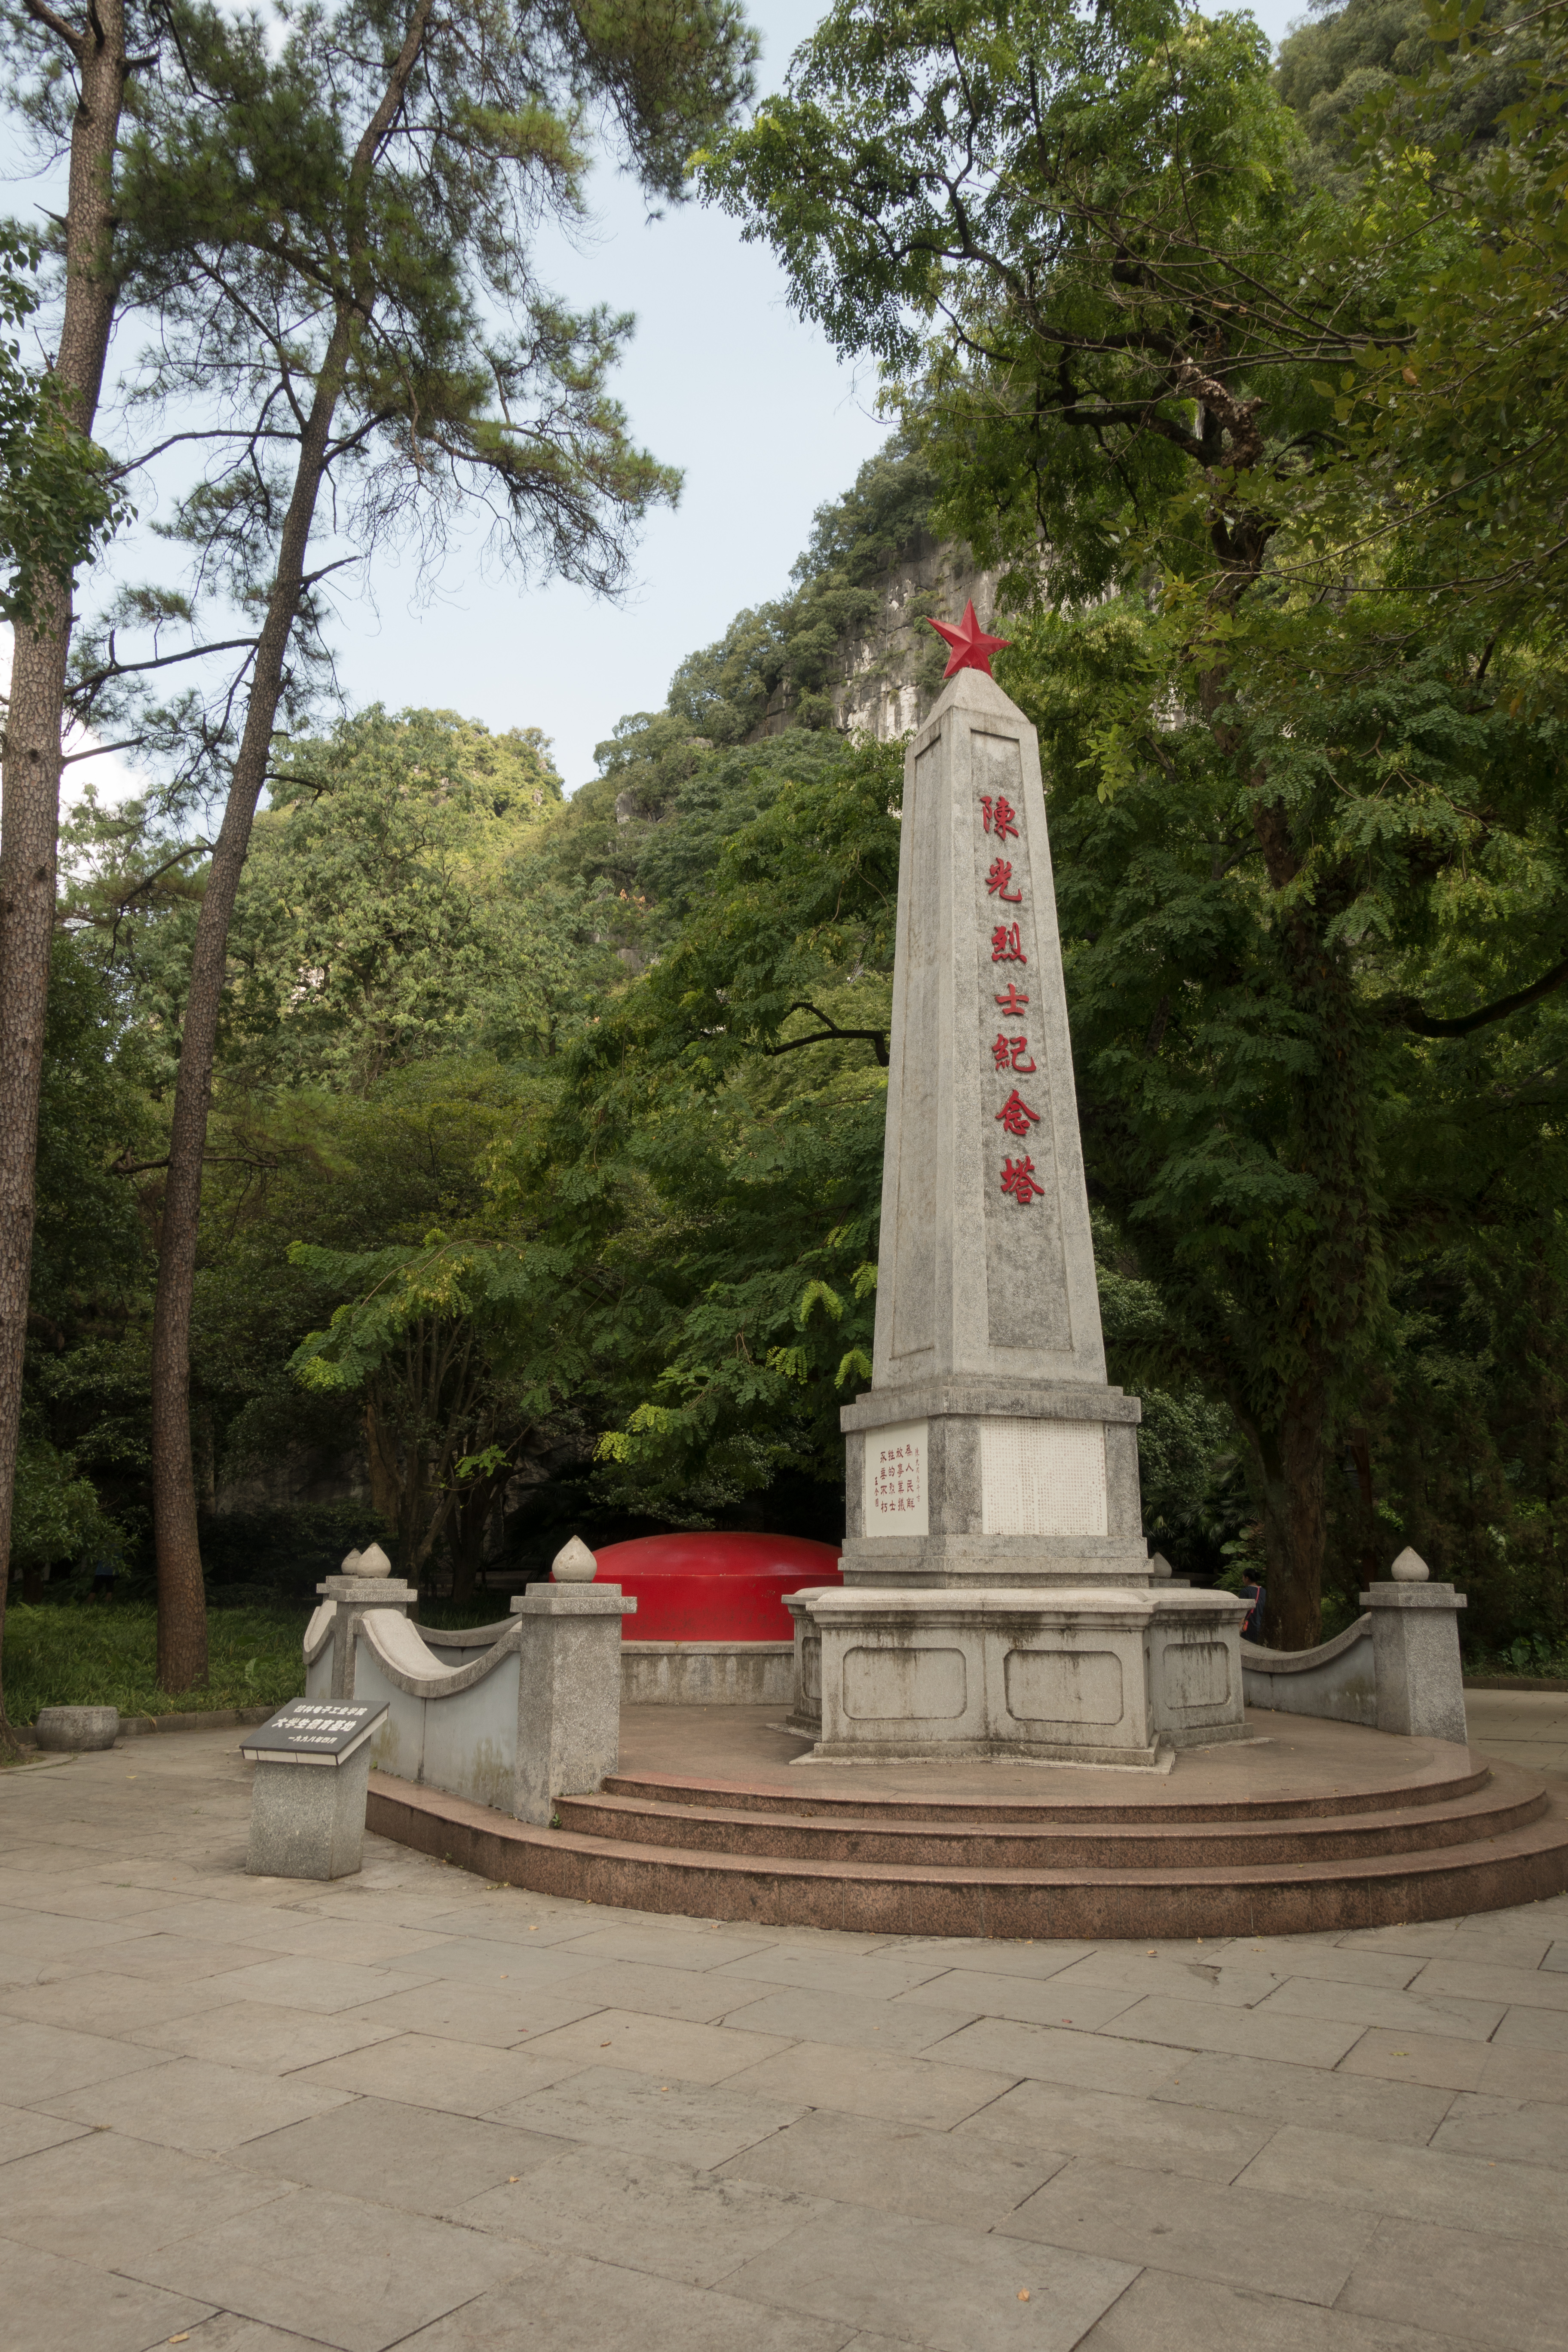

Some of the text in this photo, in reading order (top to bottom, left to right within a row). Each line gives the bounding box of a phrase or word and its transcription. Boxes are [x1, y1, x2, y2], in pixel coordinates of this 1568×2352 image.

[981, 796, 1044, 1203] 陳光烈士紀念塔
[896, 1447, 906, 1512] 放事業犧
[294, 1705, 368, 1715] 桂林电子工业学院
[272, 1718, 357, 1731] 大学生德育基地
[288, 1735, 337, 1743] 一九九八年四月
